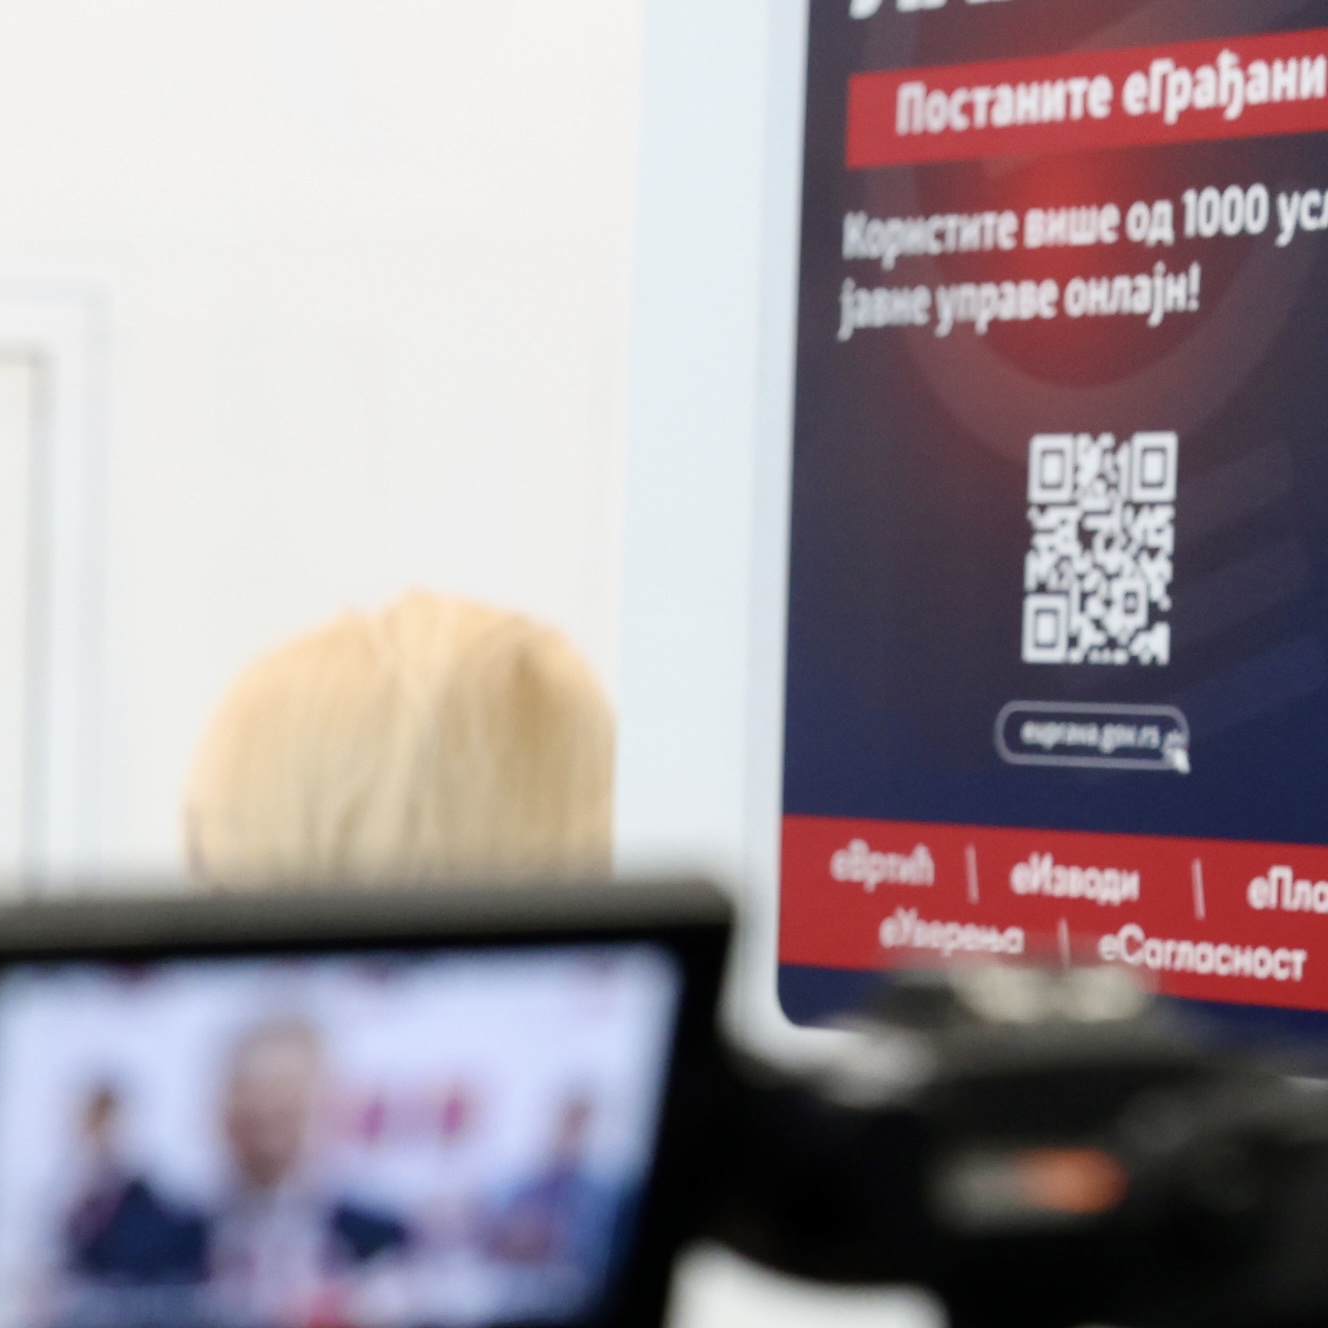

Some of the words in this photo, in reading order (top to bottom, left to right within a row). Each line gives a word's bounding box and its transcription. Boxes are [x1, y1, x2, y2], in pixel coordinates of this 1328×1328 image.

[895, 75, 1113, 136] Постаните
[842, 209, 1018, 271] Користите
[1023, 203, 1120, 249] више
[1125, 199, 1175, 248] од
[1181, 182, 1270, 239] 1000
[837, 277, 932, 342] јавне
[935, 279, 1059, 338] управе
[1064, 259, 1202, 328] онлајн!
[1010, 851, 1141, 906] еИзводи
[1097, 923, 1308, 981] еСагласност
